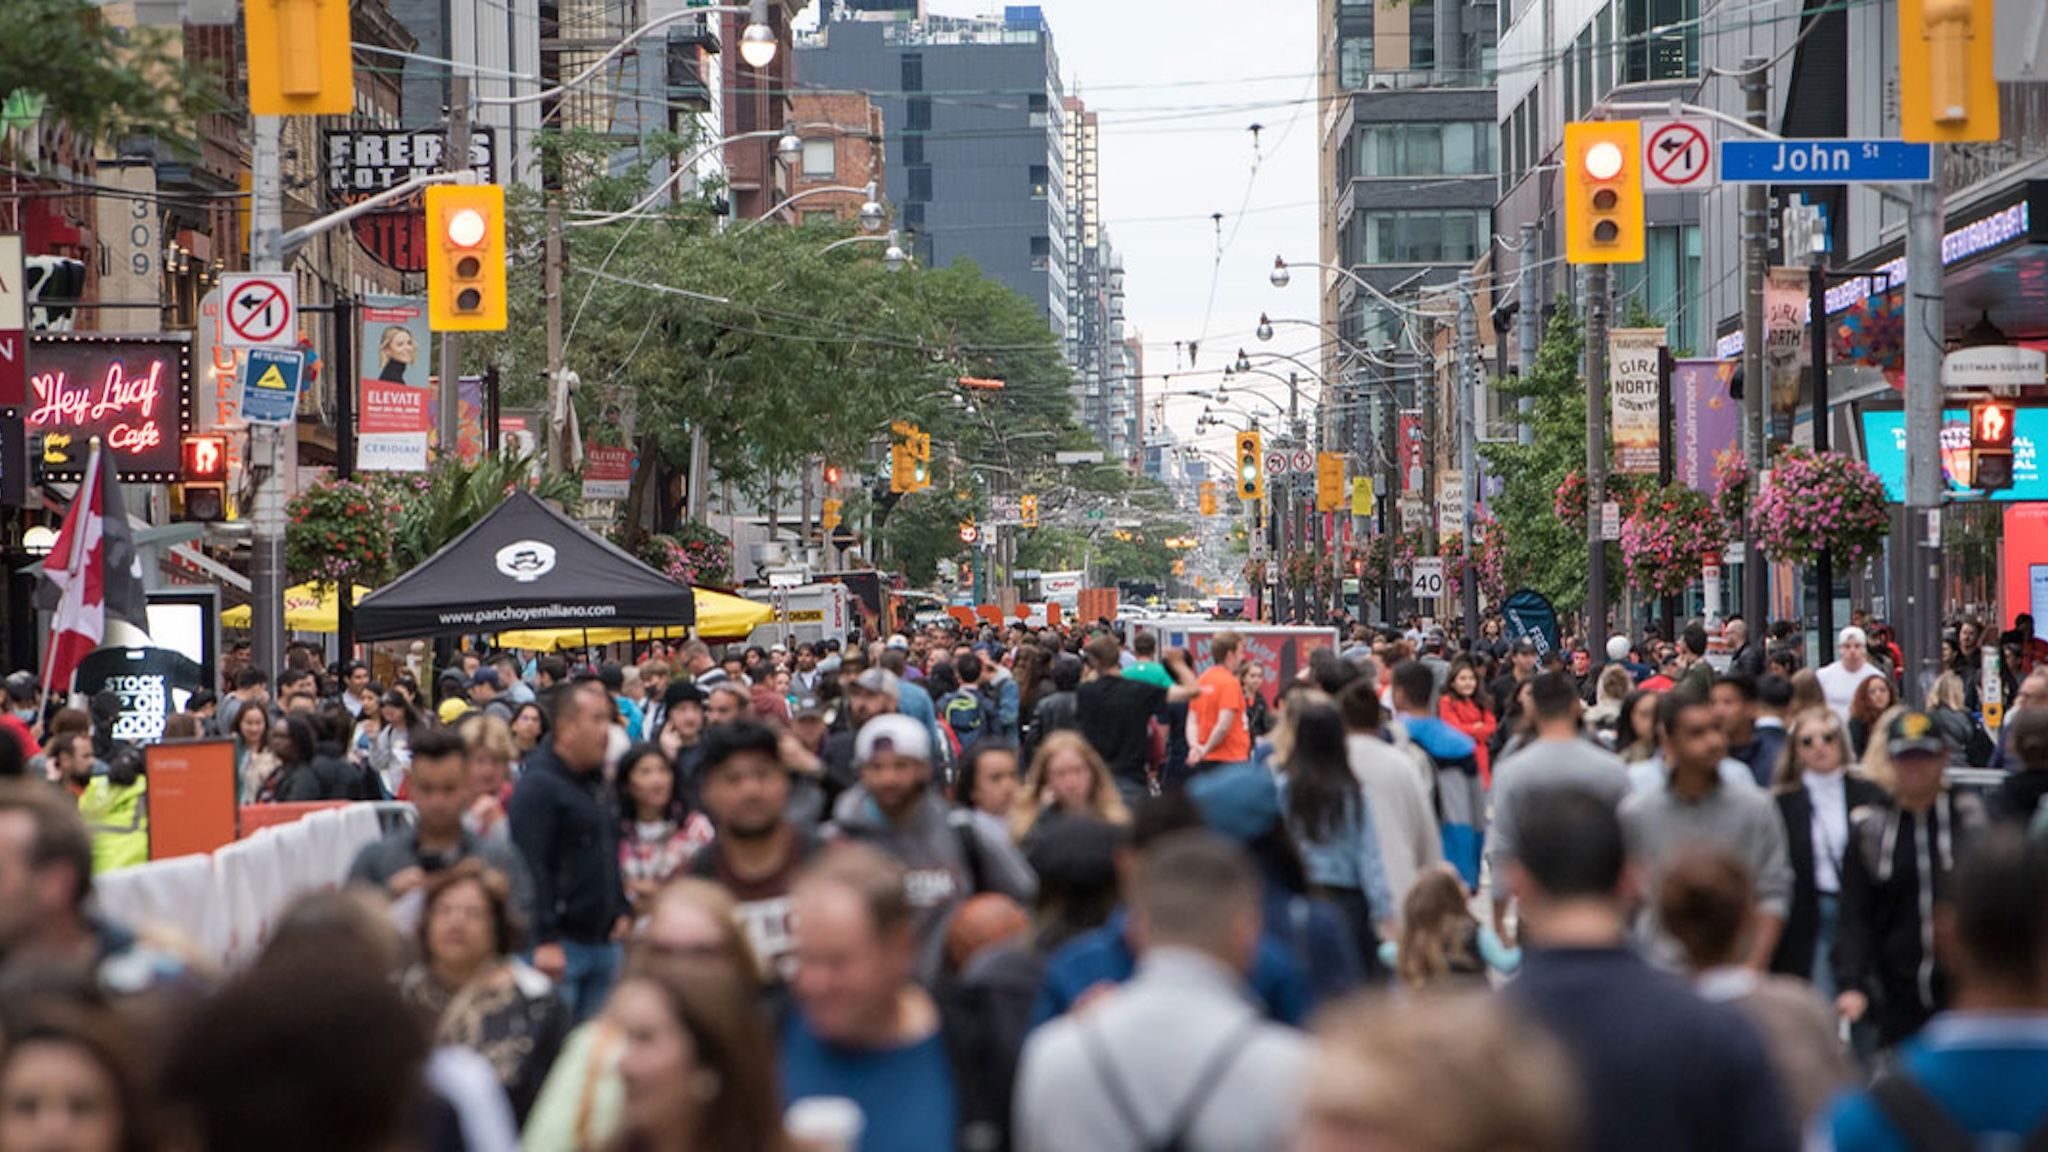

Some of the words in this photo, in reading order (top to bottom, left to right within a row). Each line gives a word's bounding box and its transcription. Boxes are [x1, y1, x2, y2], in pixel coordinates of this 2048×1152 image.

[1772, 144, 1849, 172] John
[1862, 143, 1879, 159] St
[131, 195, 149, 275] 309
[1619, 359, 1658, 376] GIRL
[2000, 362, 2040, 371] SQUARE
[31, 371, 91, 425] Hey
[91, 361, 162, 419] Lucy
[367, 391, 422, 406] ELEVATE
[108, 421, 160, 452] Cafe
[364, 442, 421, 454] CERIDIAN
[1415, 574, 1441, 592] 40
[439, 604, 616, 624] www.panchoyemiliano.com
[104, 674, 165, 692] STOCK
